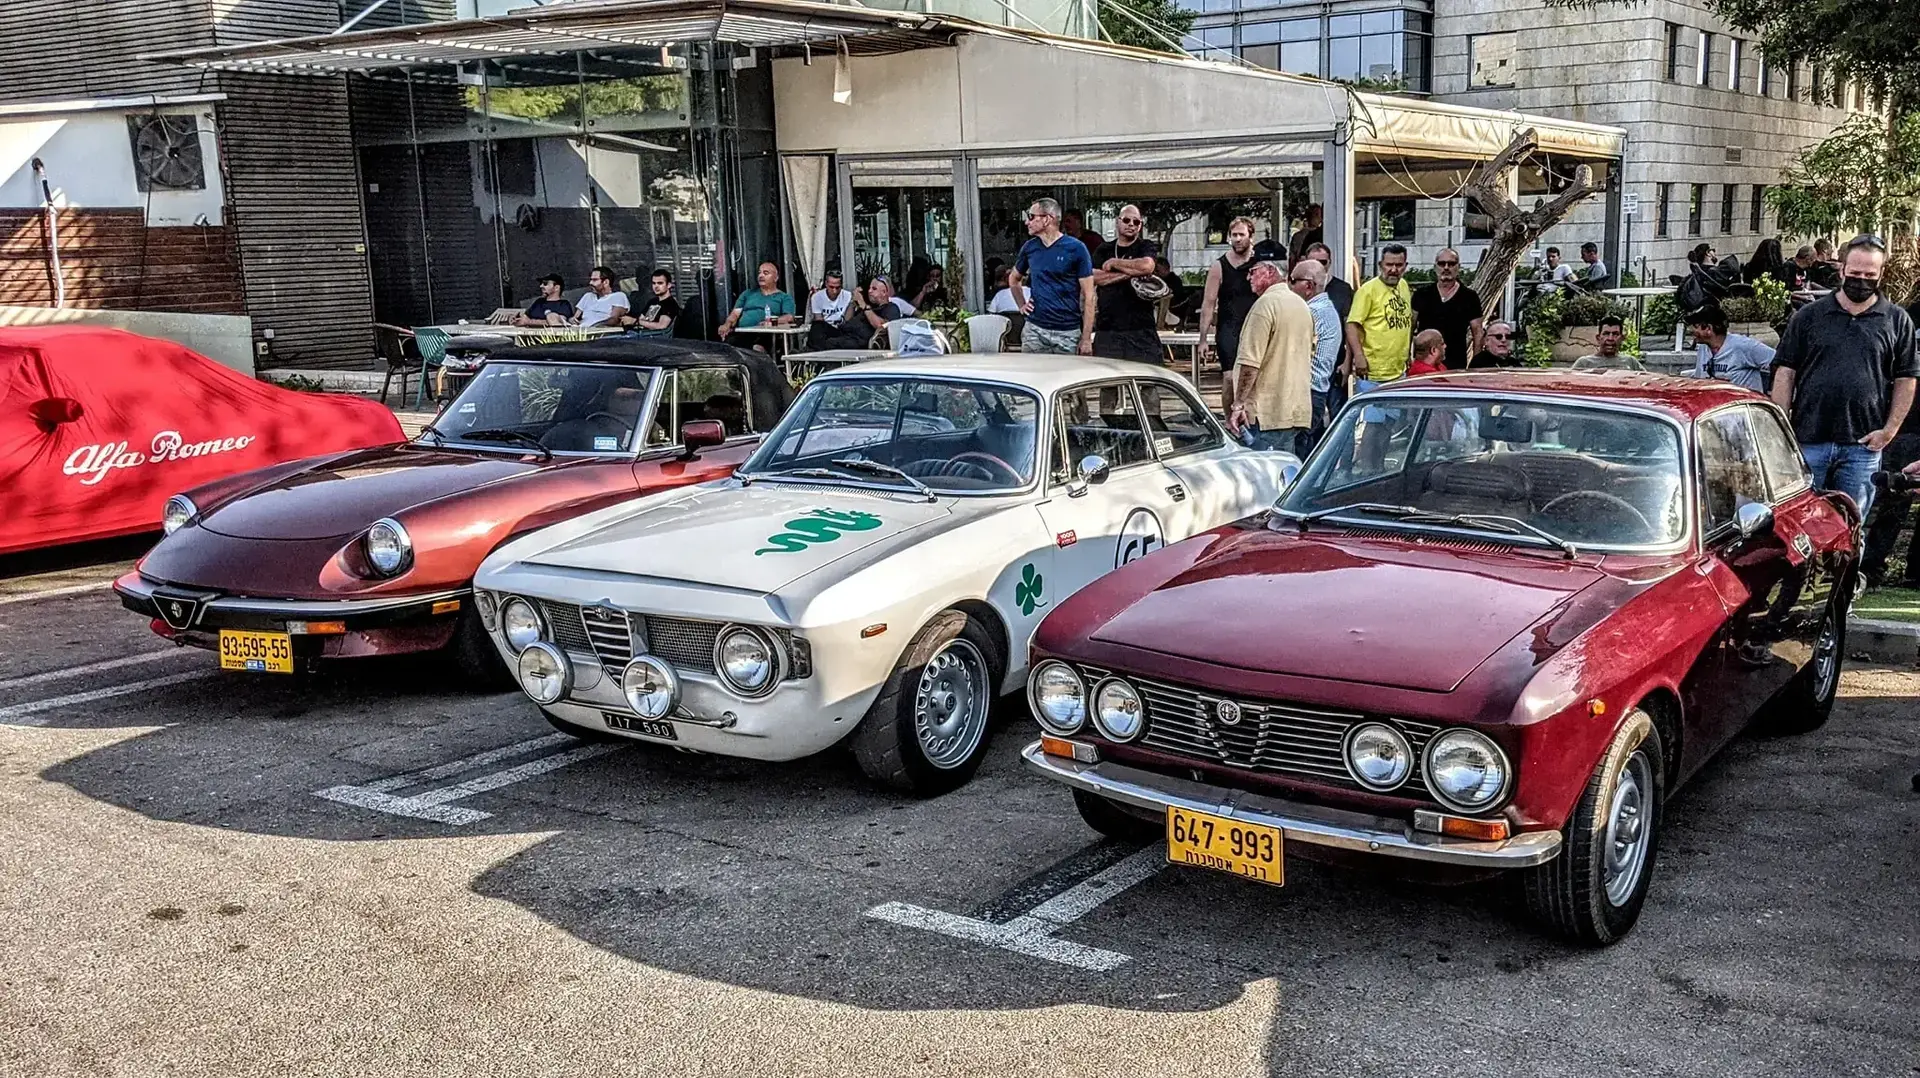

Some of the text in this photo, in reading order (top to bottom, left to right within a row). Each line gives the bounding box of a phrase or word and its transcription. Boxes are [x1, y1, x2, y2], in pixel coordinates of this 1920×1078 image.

[62, 430, 256, 486] Alfa Romeo
[605, 714, 670, 737] 717 580
[1173, 814, 1274, 863] 647-993
[1185, 849, 1267, 880] רכב אספנות
